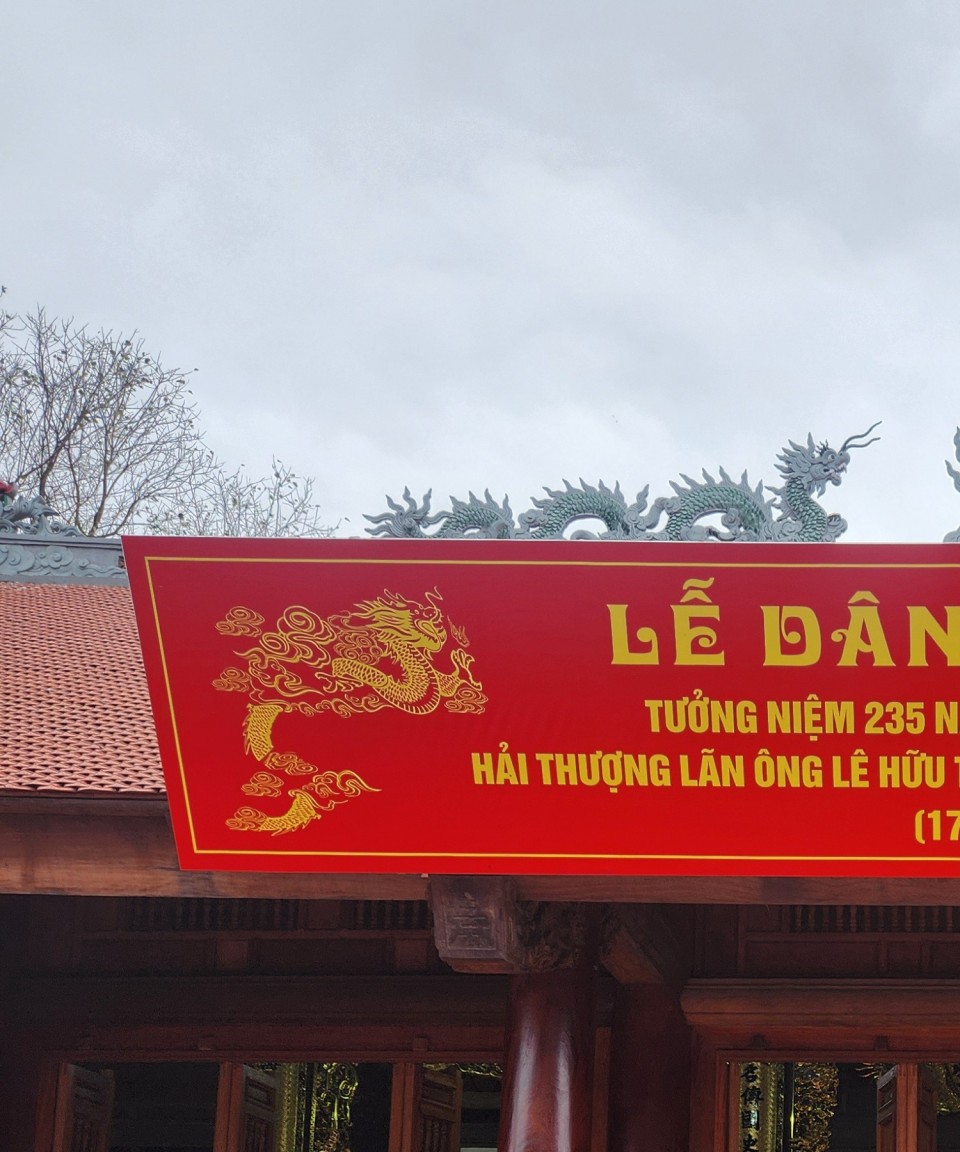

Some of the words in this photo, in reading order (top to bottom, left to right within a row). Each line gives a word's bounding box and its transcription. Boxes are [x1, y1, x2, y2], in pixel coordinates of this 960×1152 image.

[606, 576, 726, 666] LỄ
[644, 688, 758, 734] TƯỞNG
[766, 693, 855, 742] NIỆM
[864, 701, 926, 735] 235
[471, 741, 529, 785] HẢI
[535, 750, 672, 794] THƯỢNG
[679, 748, 745, 788] LÃN
[753, 747, 823, 789] ÔNG
[832, 748, 870, 788] LÊ
[878, 749, 946, 789] HỮU
